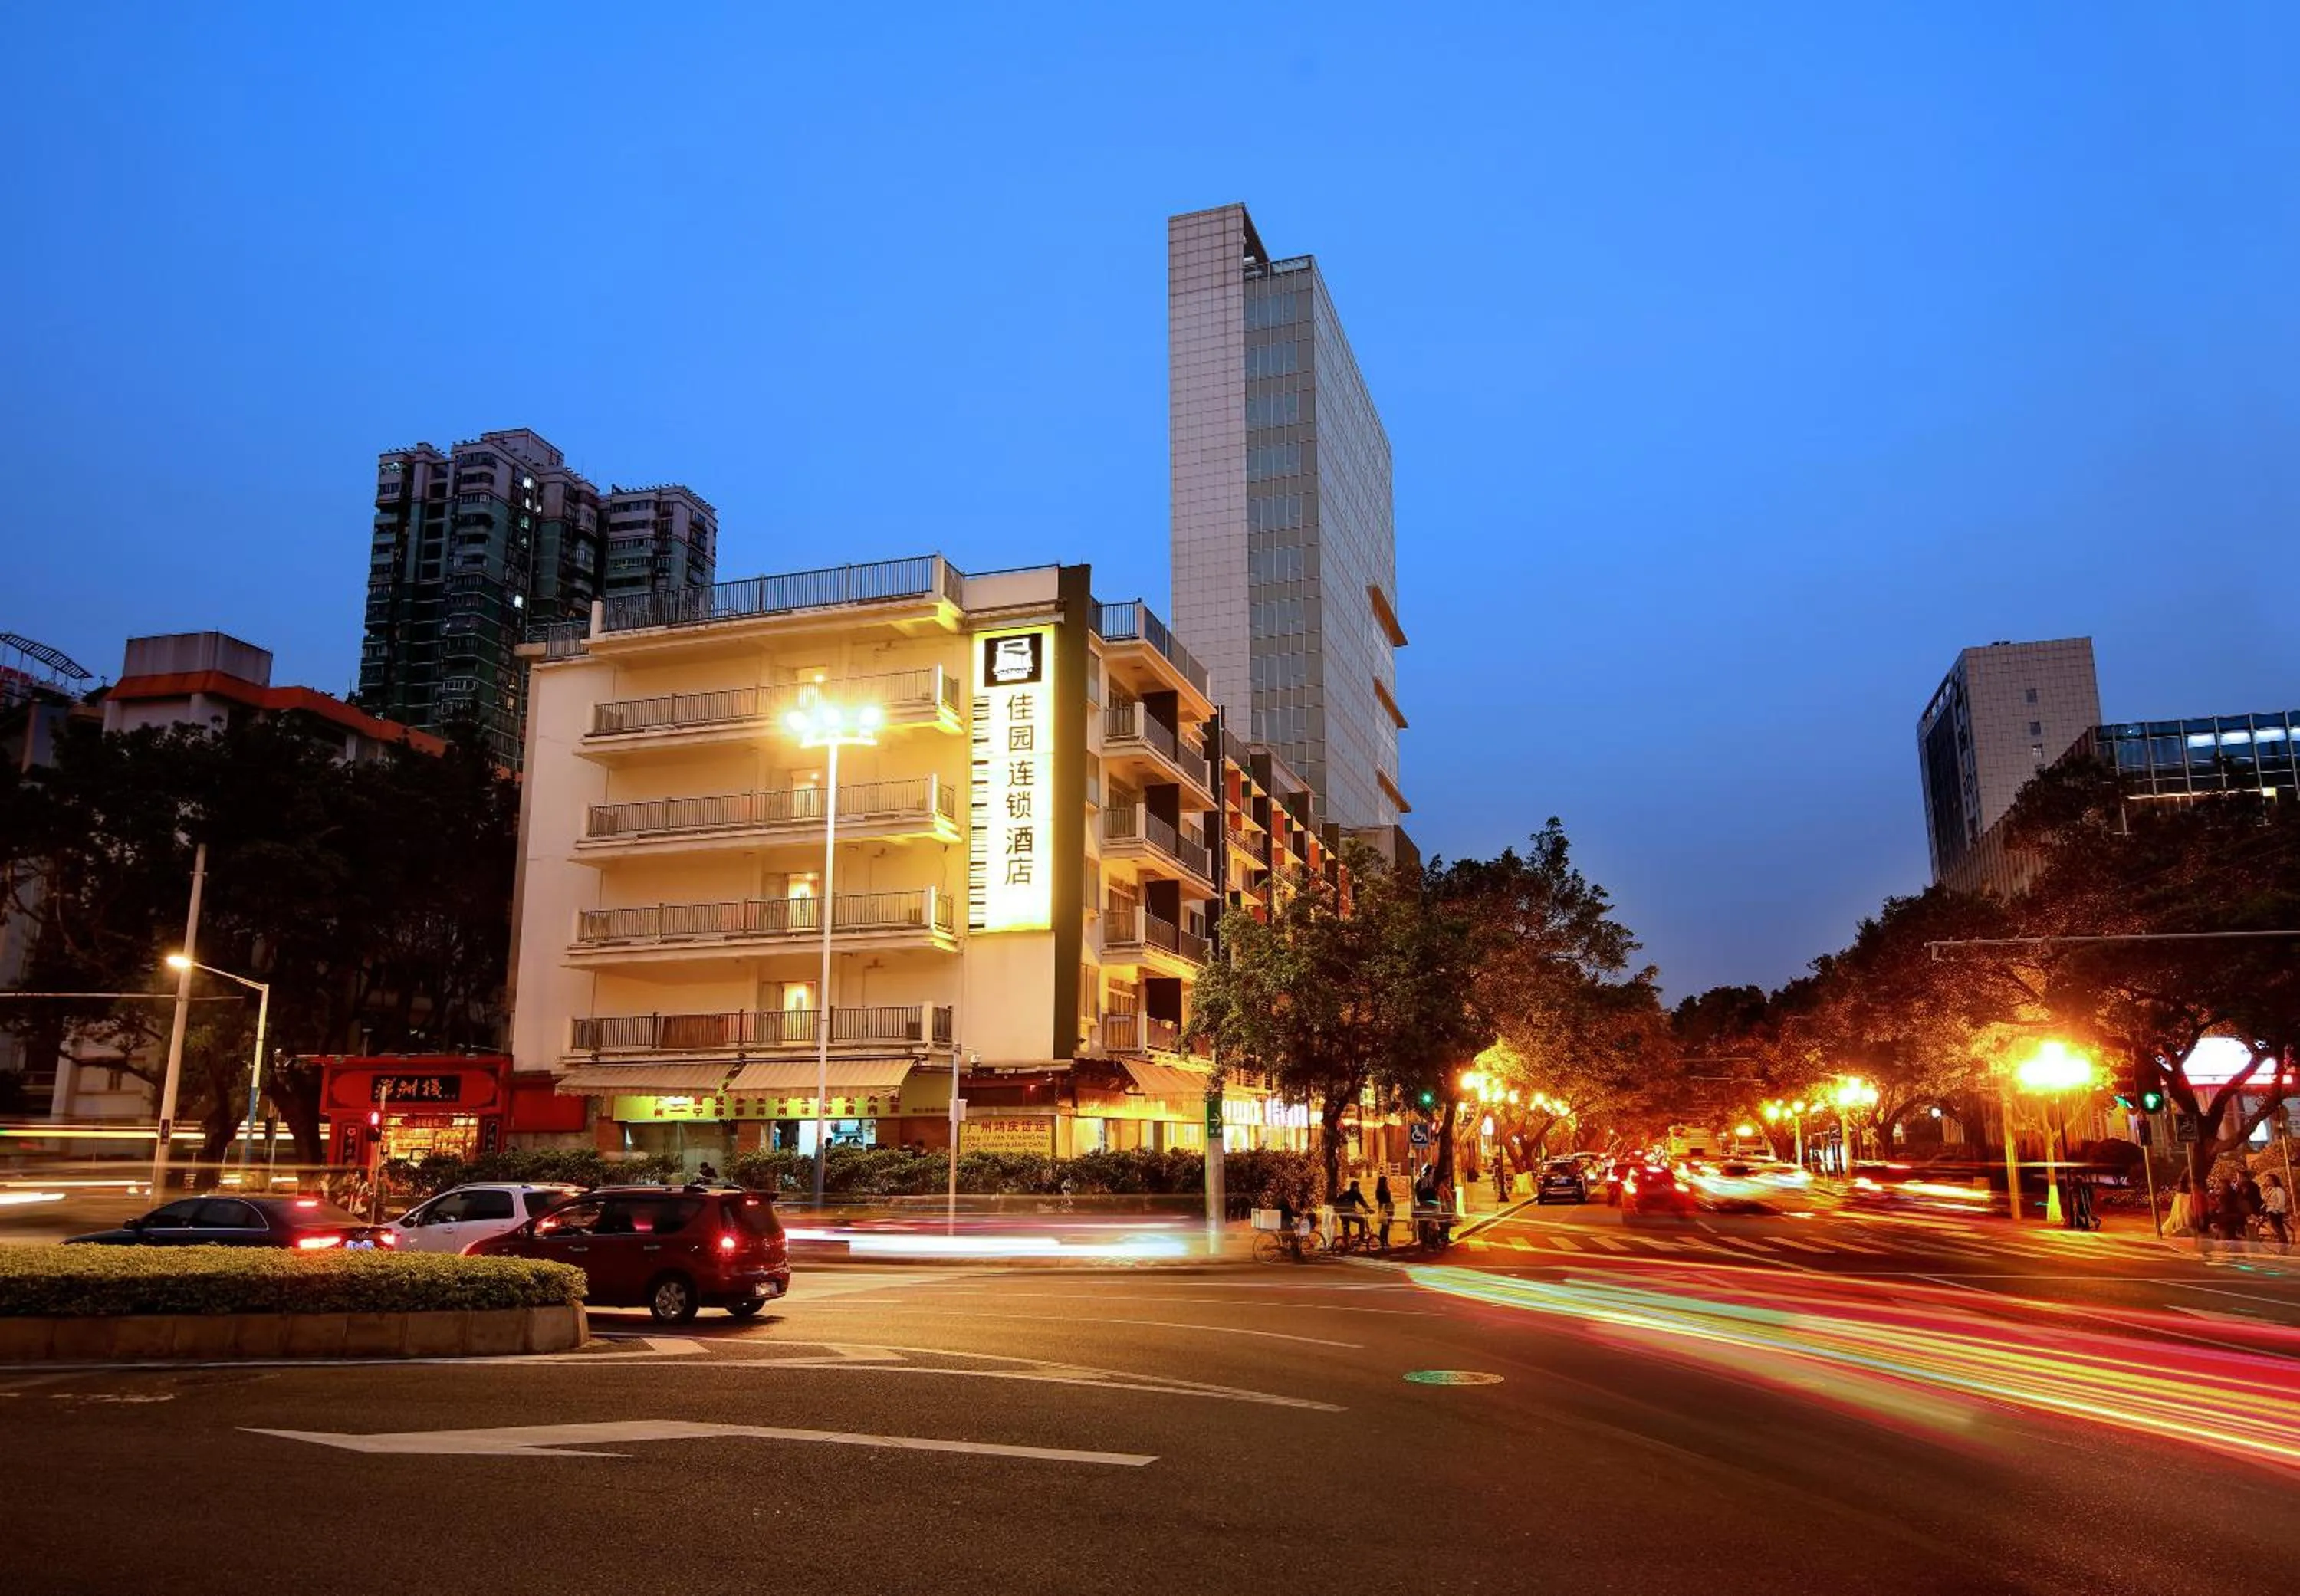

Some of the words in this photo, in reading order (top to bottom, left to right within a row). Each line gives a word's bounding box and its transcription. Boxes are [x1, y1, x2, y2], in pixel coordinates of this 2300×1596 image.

[1006, 692, 1034, 885] 佳园连锁酒店
